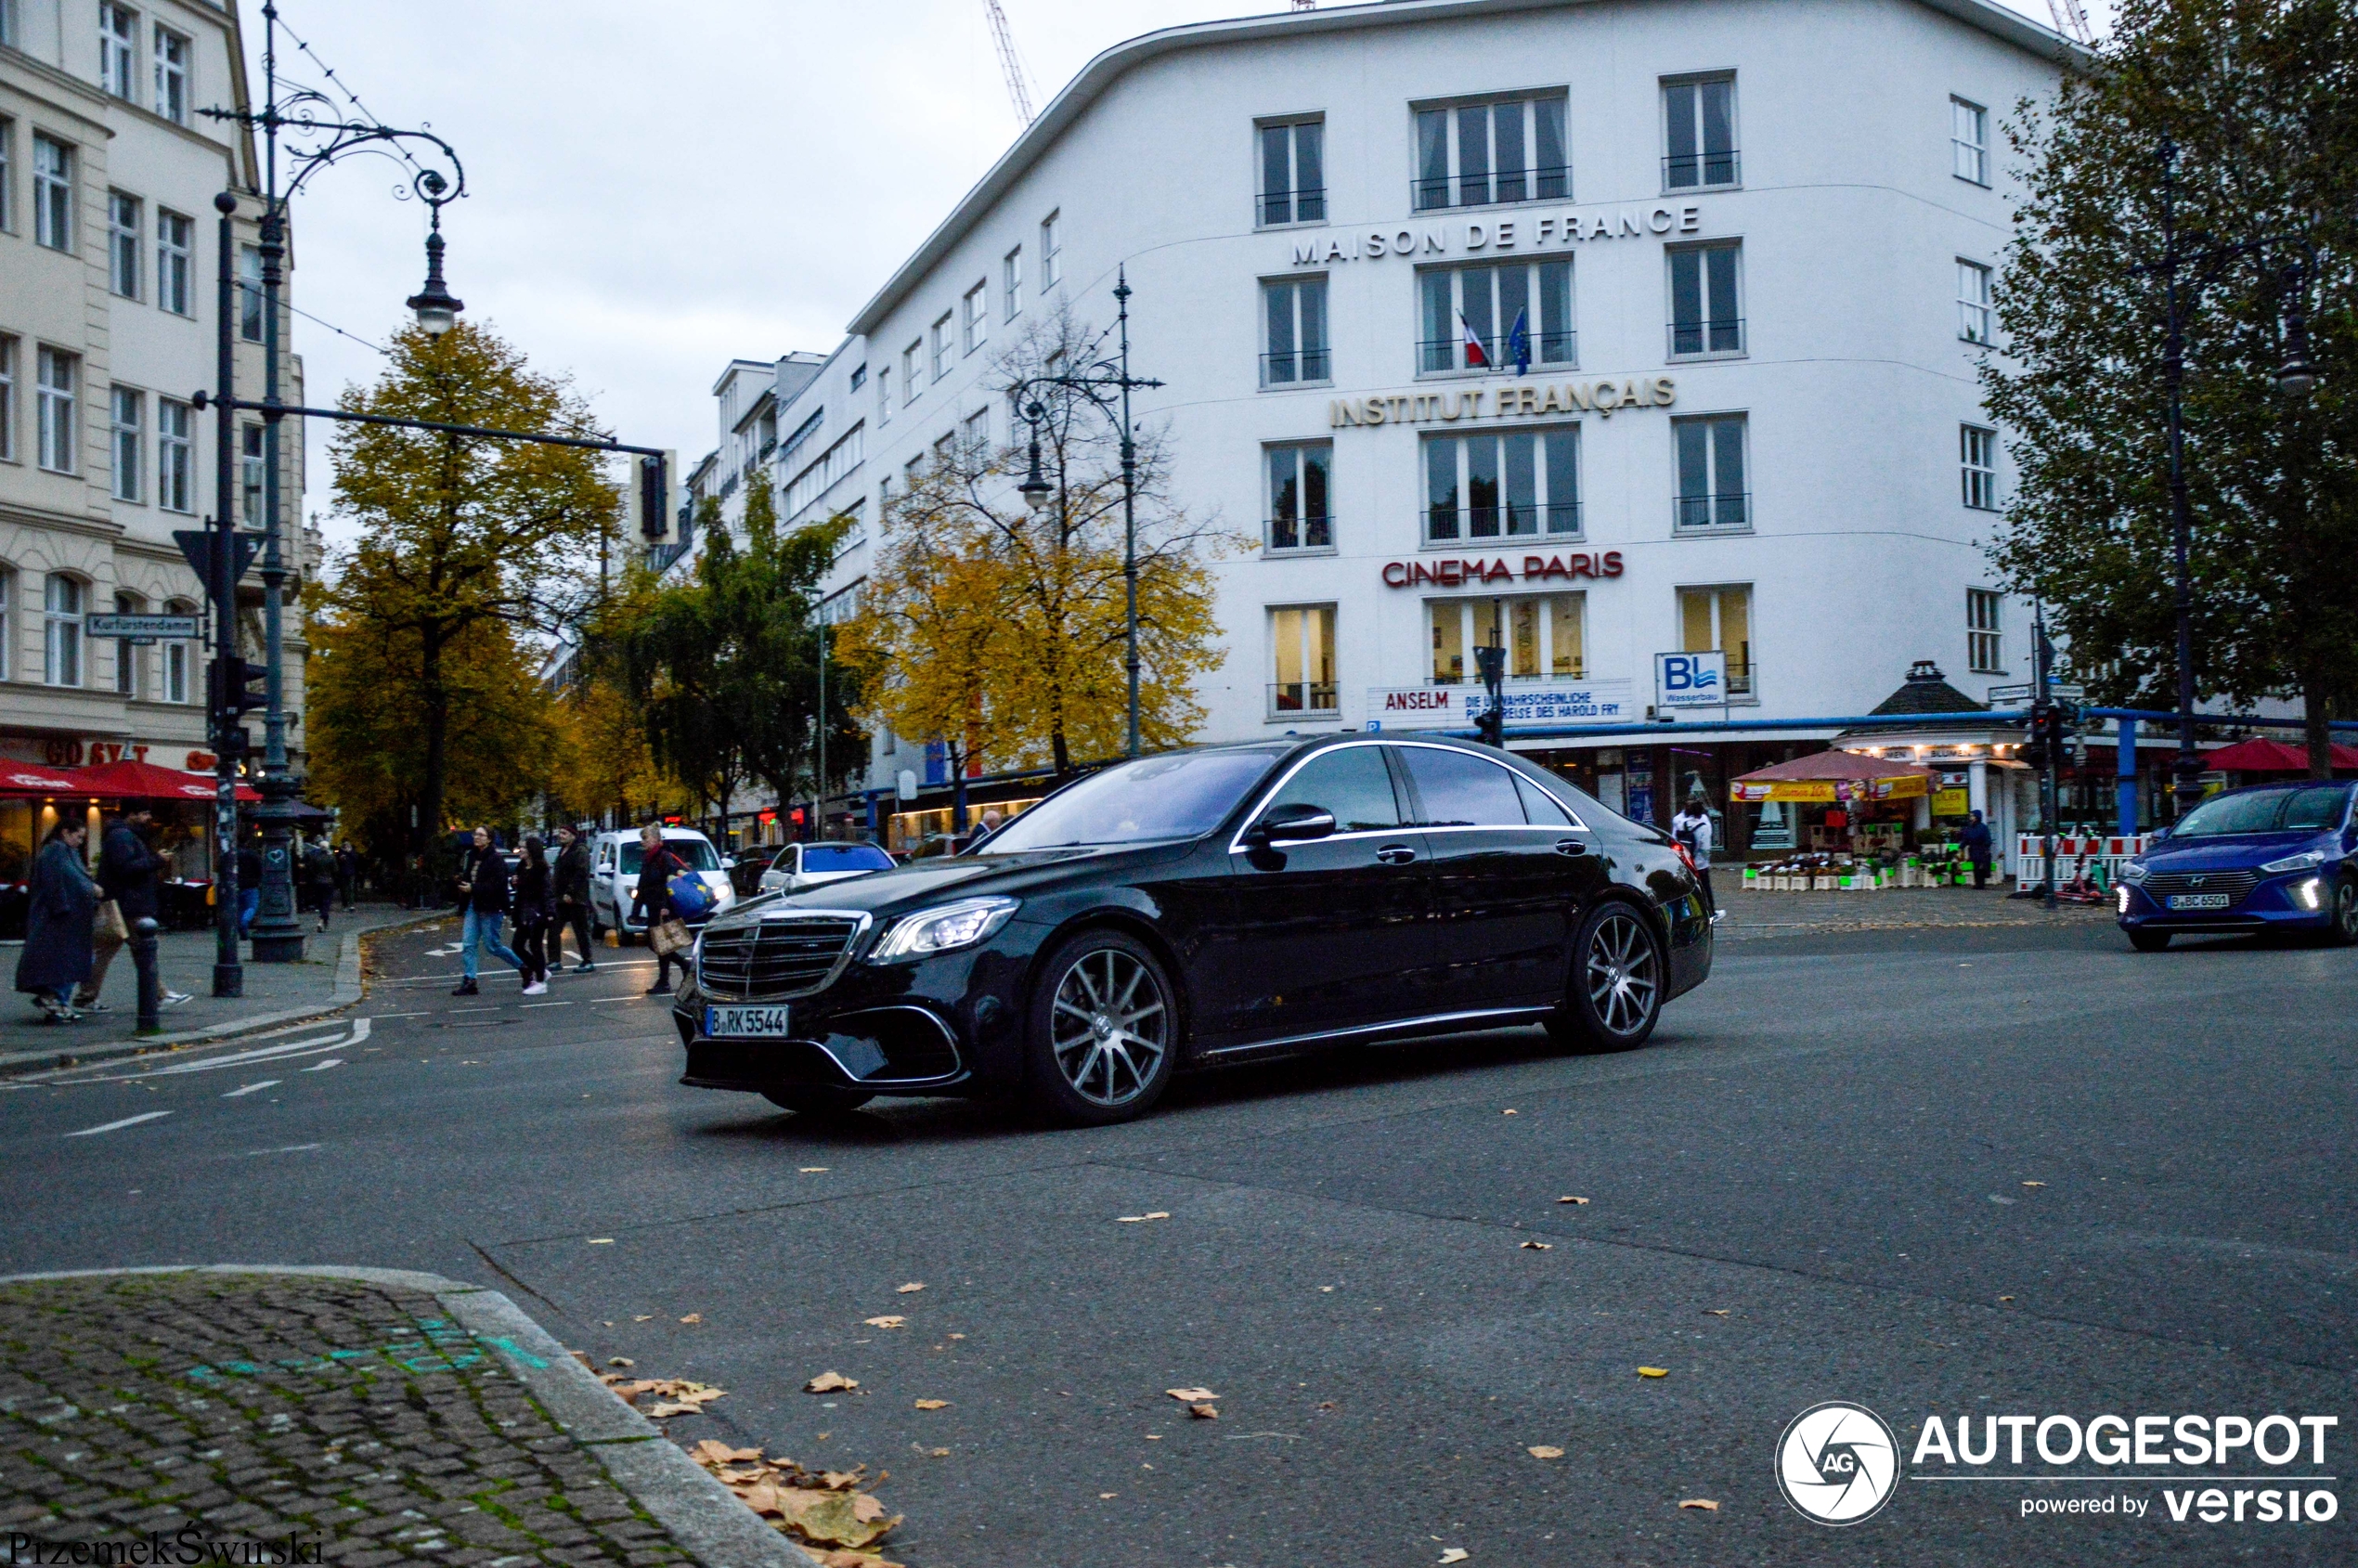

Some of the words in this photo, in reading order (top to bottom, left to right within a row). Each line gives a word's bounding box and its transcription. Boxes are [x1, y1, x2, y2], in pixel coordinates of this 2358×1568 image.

[1292, 230, 1445, 265] MAISON
[1466, 222, 1514, 250] DE
[1535, 205, 1700, 244] FRANCE
[1329, 388, 1483, 427] INSTITUT
[1495, 376, 1676, 418] FRANÇAIS
[1381, 557, 1513, 588] CINEMA
[1522, 551, 1625, 581] PARIS
[1665, 656, 1717, 691] BL
[1385, 692, 1448, 710] ANSELM
[1466, 695, 1480, 707] DIE
[1484, 692, 1591, 706] UWAHRSCHEINLICHE
[1665, 693, 1718, 703] Wasserbau
[1536, 706, 1554, 719] DES
[1559, 704, 1597, 717] HAROLD
[1601, 703, 1619, 716] FRY
[46, 742, 84, 765] GO
[90, 743, 149, 764] SYT
[2172, 897, 2179, 907] B
[713, 1010, 719, 1032] B
[728, 1010, 744, 1032] RK
[746, 1010, 784, 1032] 5544
